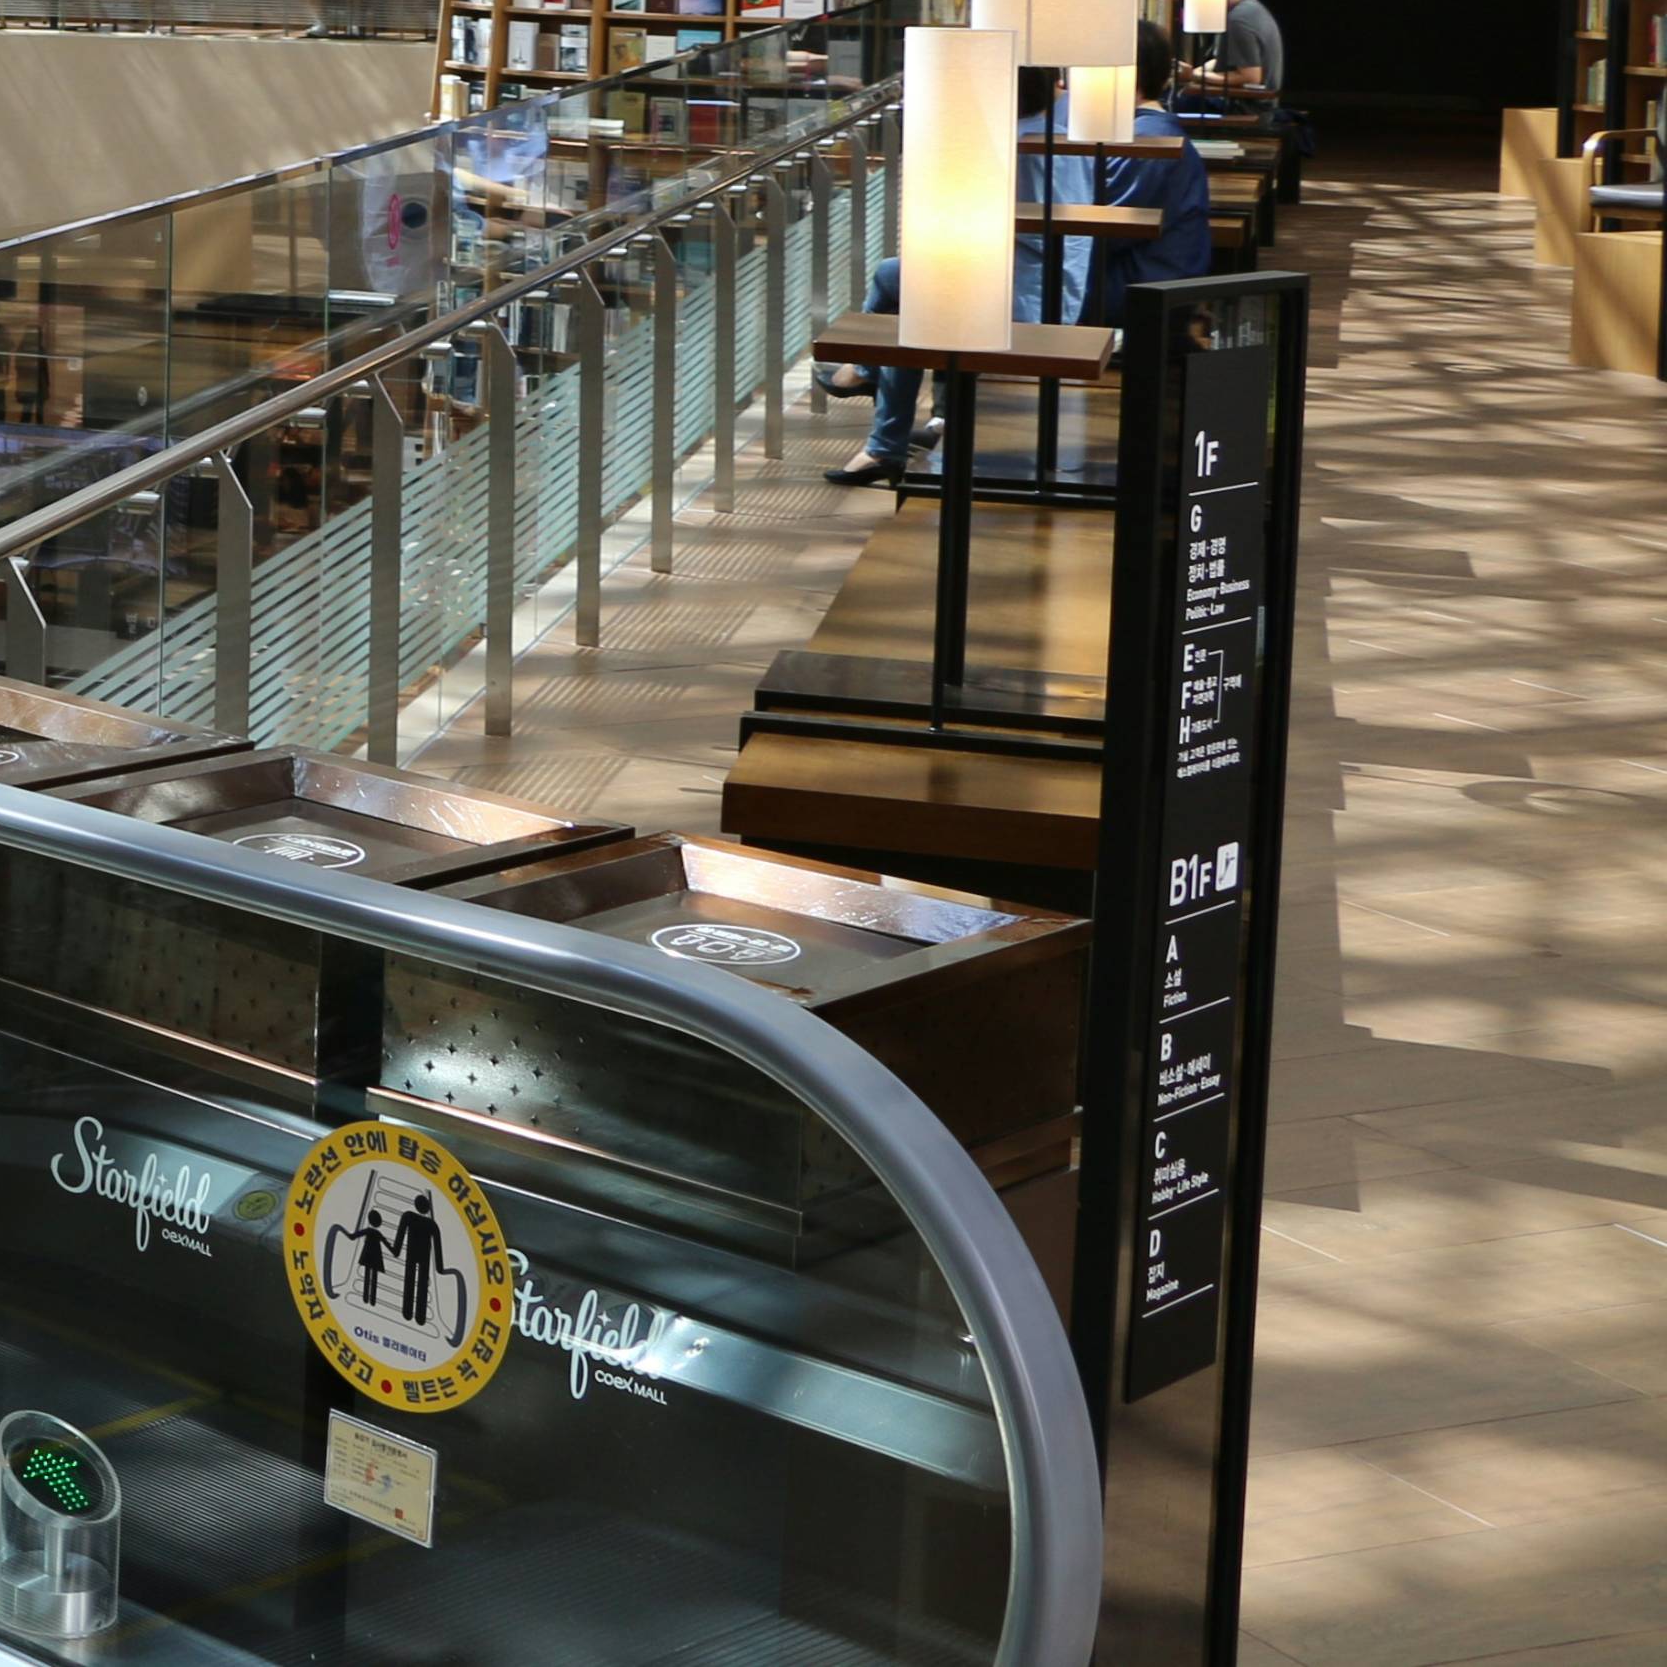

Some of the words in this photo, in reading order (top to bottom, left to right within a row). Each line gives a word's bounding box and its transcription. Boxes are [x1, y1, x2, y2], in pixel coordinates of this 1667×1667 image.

[1194, 430, 1220, 478] 1F
[1190, 504, 1203, 533] G
[1183, 643, 1195, 673] E
[1181, 680, 1193, 710] F
[1179, 715, 1191, 745] H
[1169, 853, 1213, 907] B1F
[1165, 935, 1179, 963] A
[1164, 967, 1183, 989] 소설
[1163, 991, 1188, 1008] Fiction
[1160, 1033, 1173, 1062] B
[1154, 1131, 1167, 1159] C
[51, 1116, 211, 1252] Starfield
[294, 1145, 343, 1216] 노란선
[344, 1131, 388, 1158] 안에
[397, 1134, 443, 1176] 탑승
[447, 1172, 505, 1286] 하십시오
[1149, 1229, 1161, 1258] D
[293, 1248, 326, 1321] 노약자
[320, 1327, 376, 1387] 손잡고
[354, 1326, 380, 1346] Otis
[402, 1376, 459, 1404] 벨트는
[471, 1318, 501, 1364] 잡고
